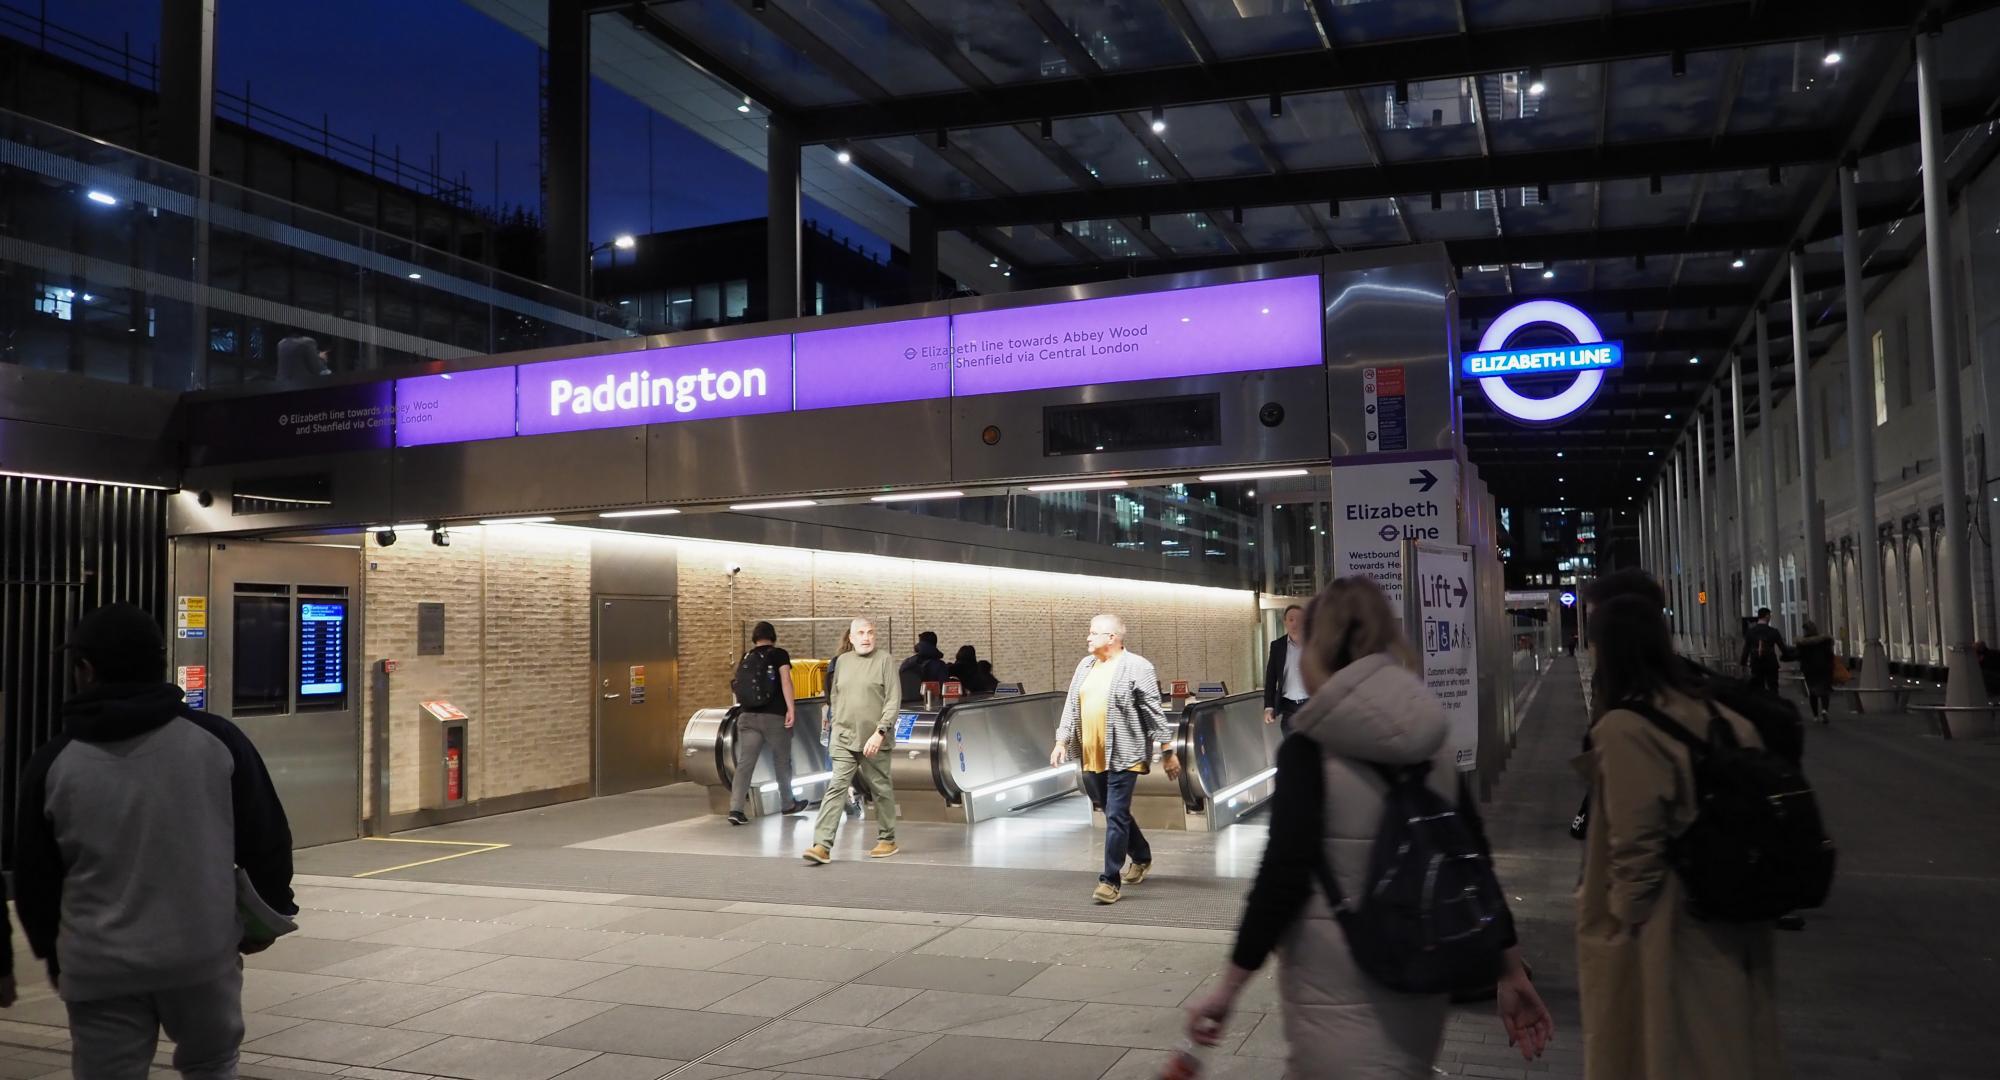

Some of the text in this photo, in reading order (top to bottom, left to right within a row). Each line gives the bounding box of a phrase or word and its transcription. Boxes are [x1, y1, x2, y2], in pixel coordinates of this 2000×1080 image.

[981, 339, 1004, 352] line
[1008, 333, 1059, 349] towards
[1063, 330, 1104, 343] Abbey
[1109, 324, 1148, 339] Wood
[956, 352, 1013, 368] Shenfield
[1017, 351, 1035, 362] via
[1039, 345, 1086, 360] Central
[1091, 342, 1139, 355] London
[1471, 347, 1612, 373] ELIZABETH LINE
[551, 367, 767, 416] Paddington
[291, 412, 327, 424] Elizabeth
[329, 408, 345, 420] line
[348, 406, 380, 418] towards
[413, 400, 439, 411] Wood
[295, 424, 311, 435] and
[312, 419, 351, 433] Shenfield
[352, 418, 365, 429] via
[401, 412, 433, 424] London
[1346, 500, 1438, 520] Elizabeth
[1403, 524, 1439, 540] line
[1348, 550, 1400, 559] Westbound
[1349, 560, 1385, 570] towards
[1421, 574, 1452, 608] Lift
